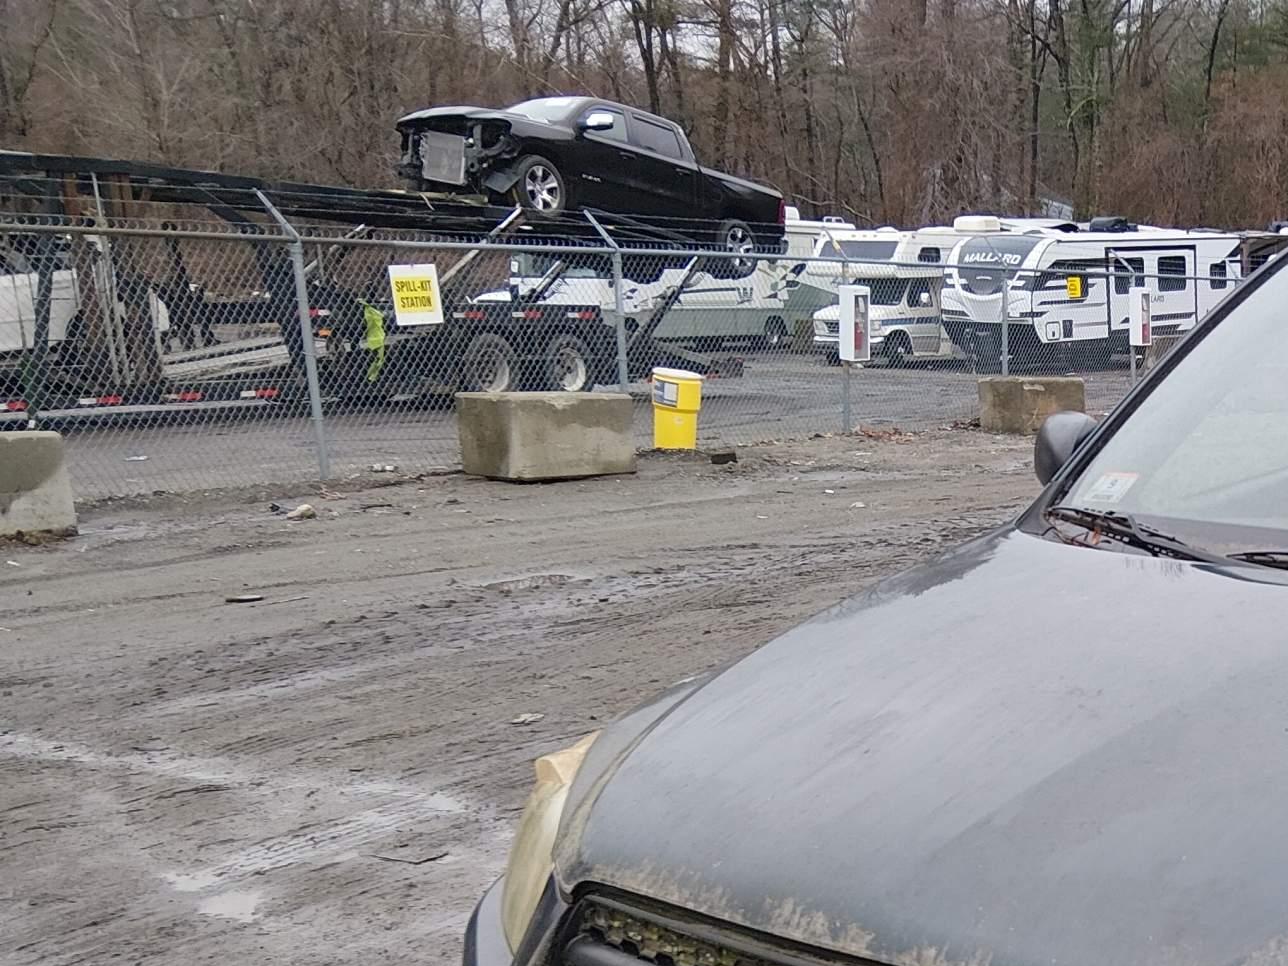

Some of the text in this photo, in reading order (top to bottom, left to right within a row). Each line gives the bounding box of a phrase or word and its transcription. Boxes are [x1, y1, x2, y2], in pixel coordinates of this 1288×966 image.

[963, 252, 1021, 265] MALLARD
[395, 280, 432, 292] SPILL-KIT
[400, 296, 432, 308] STATION
